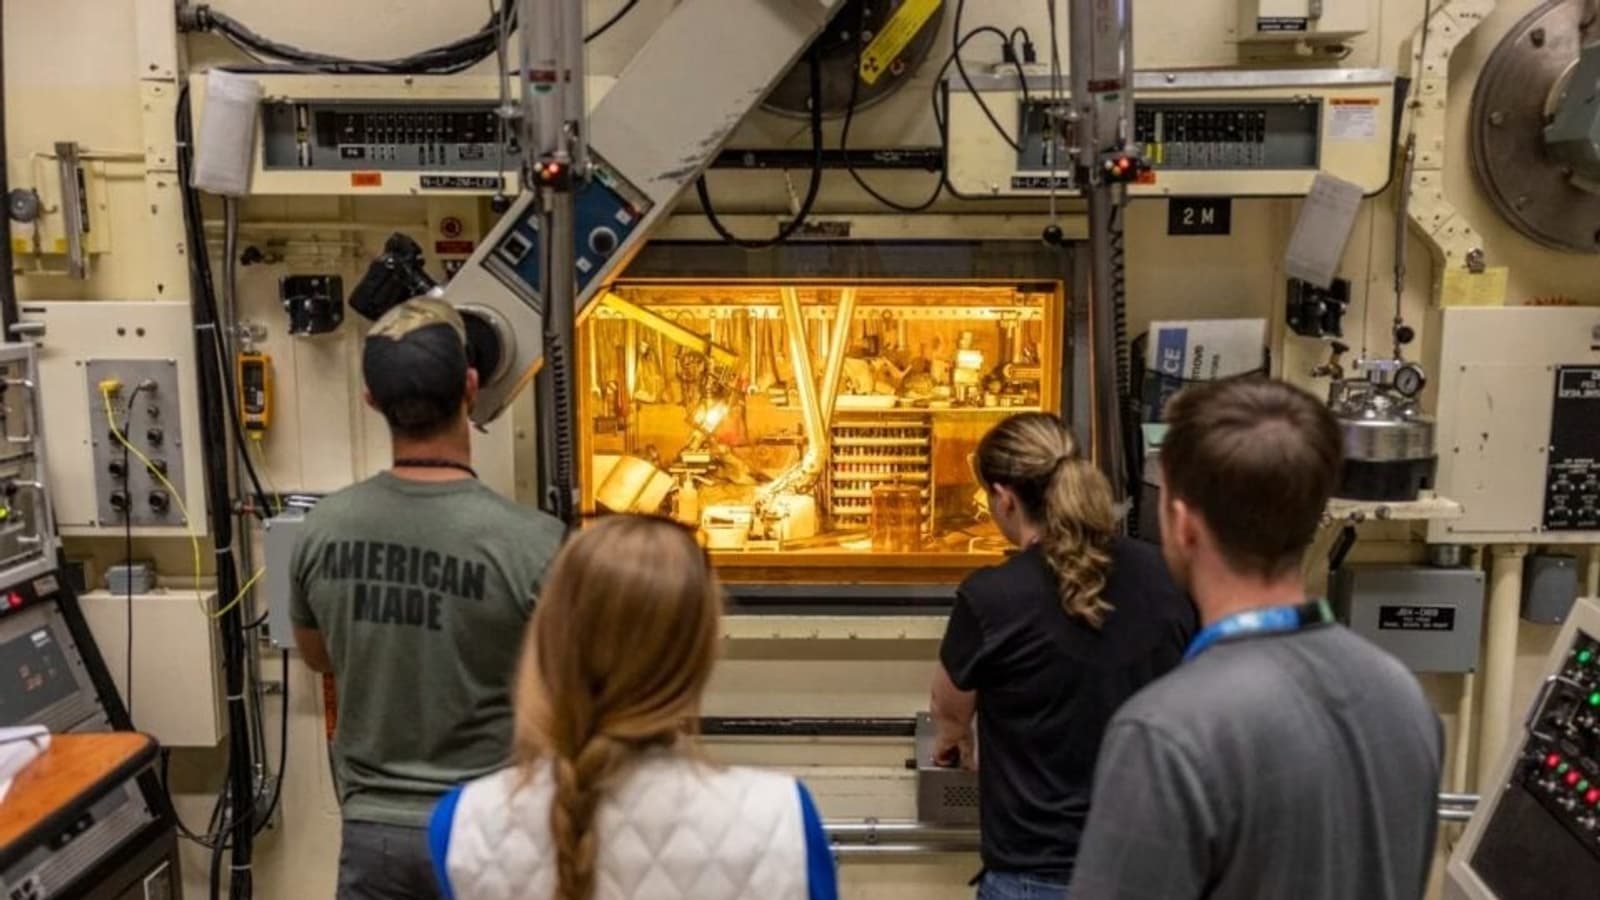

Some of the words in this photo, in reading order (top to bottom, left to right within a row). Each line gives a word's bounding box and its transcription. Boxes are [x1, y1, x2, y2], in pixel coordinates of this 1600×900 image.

[1183, 207, 1194, 225] 2
[1201, 207, 1214, 225] M
[322, 541, 486, 600] AMERICAN
[354, 583, 444, 631] MADE
